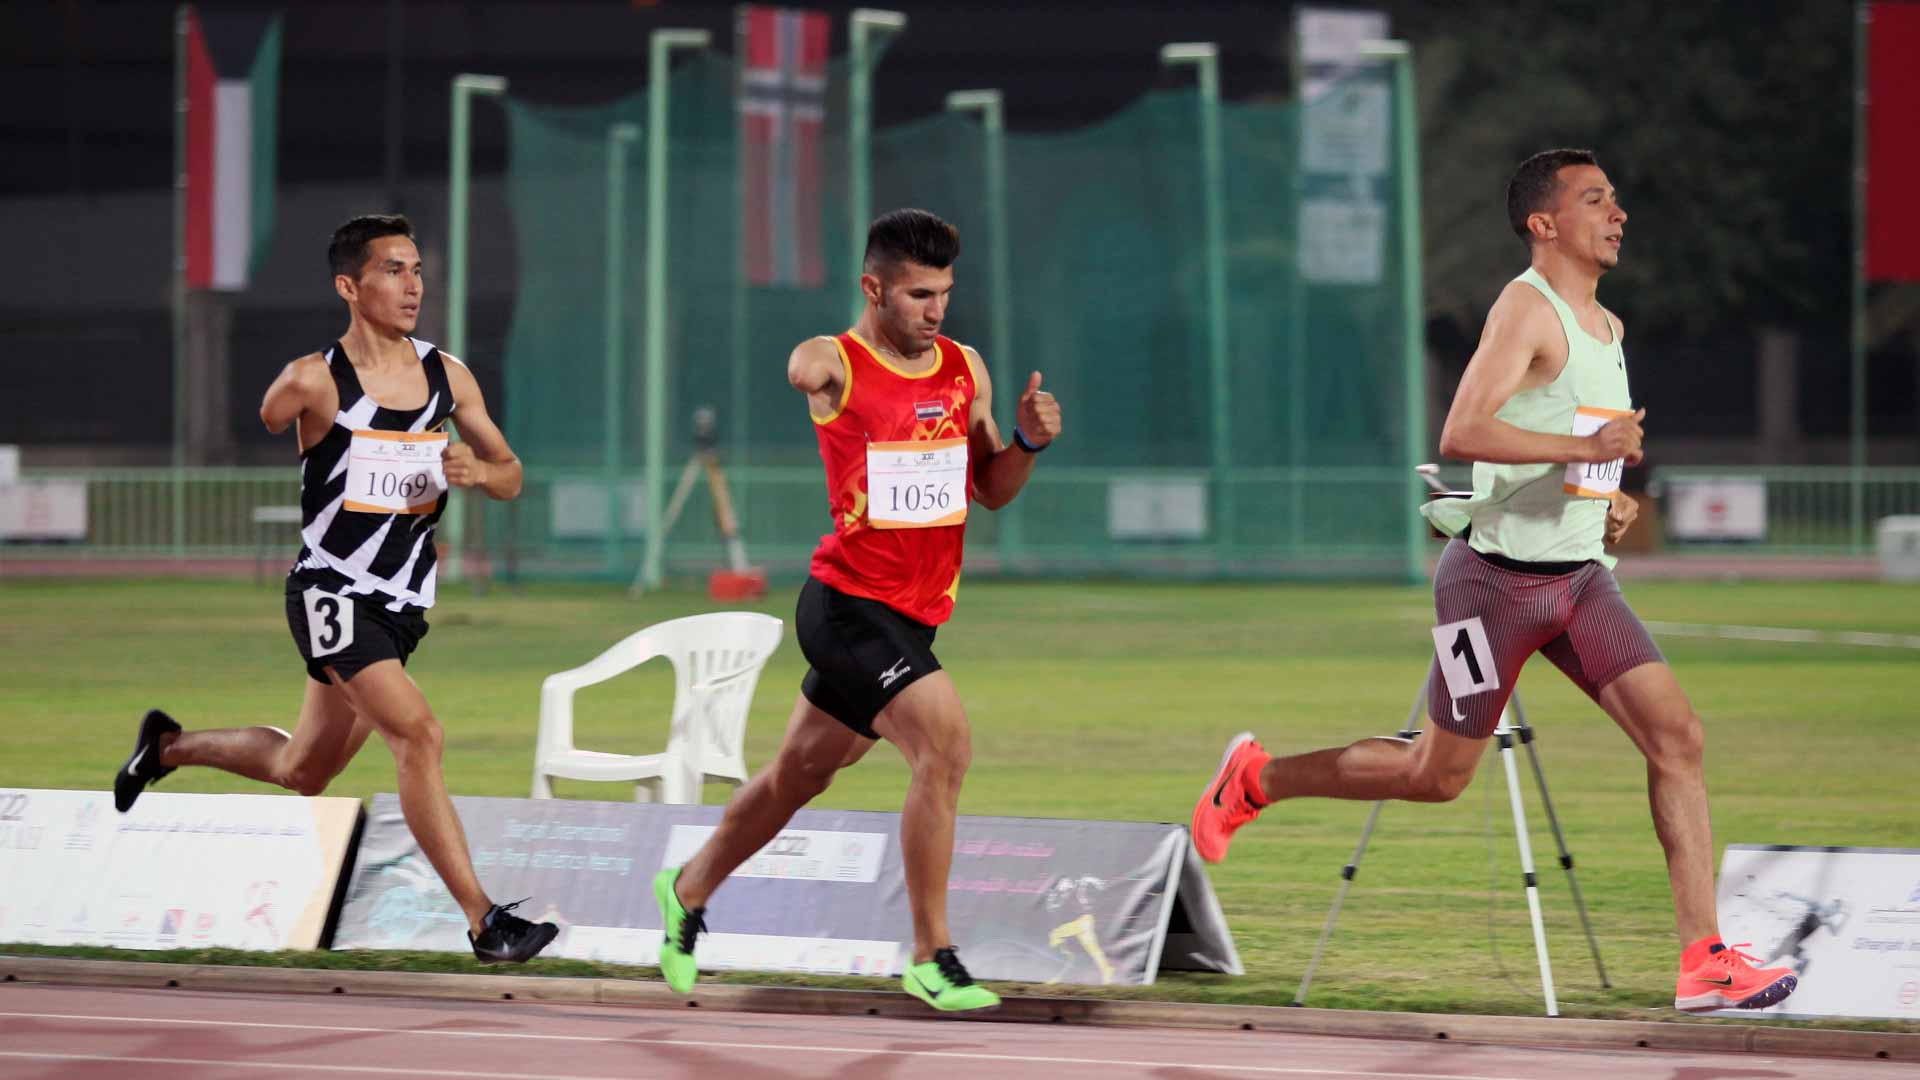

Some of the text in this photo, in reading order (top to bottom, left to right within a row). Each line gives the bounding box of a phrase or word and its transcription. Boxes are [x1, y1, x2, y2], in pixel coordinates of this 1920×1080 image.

[366, 471, 428, 498] 1069
[889, 482, 950, 511] 1056
[315, 597, 342, 650] 3
[1451, 628, 1485, 685] 1
